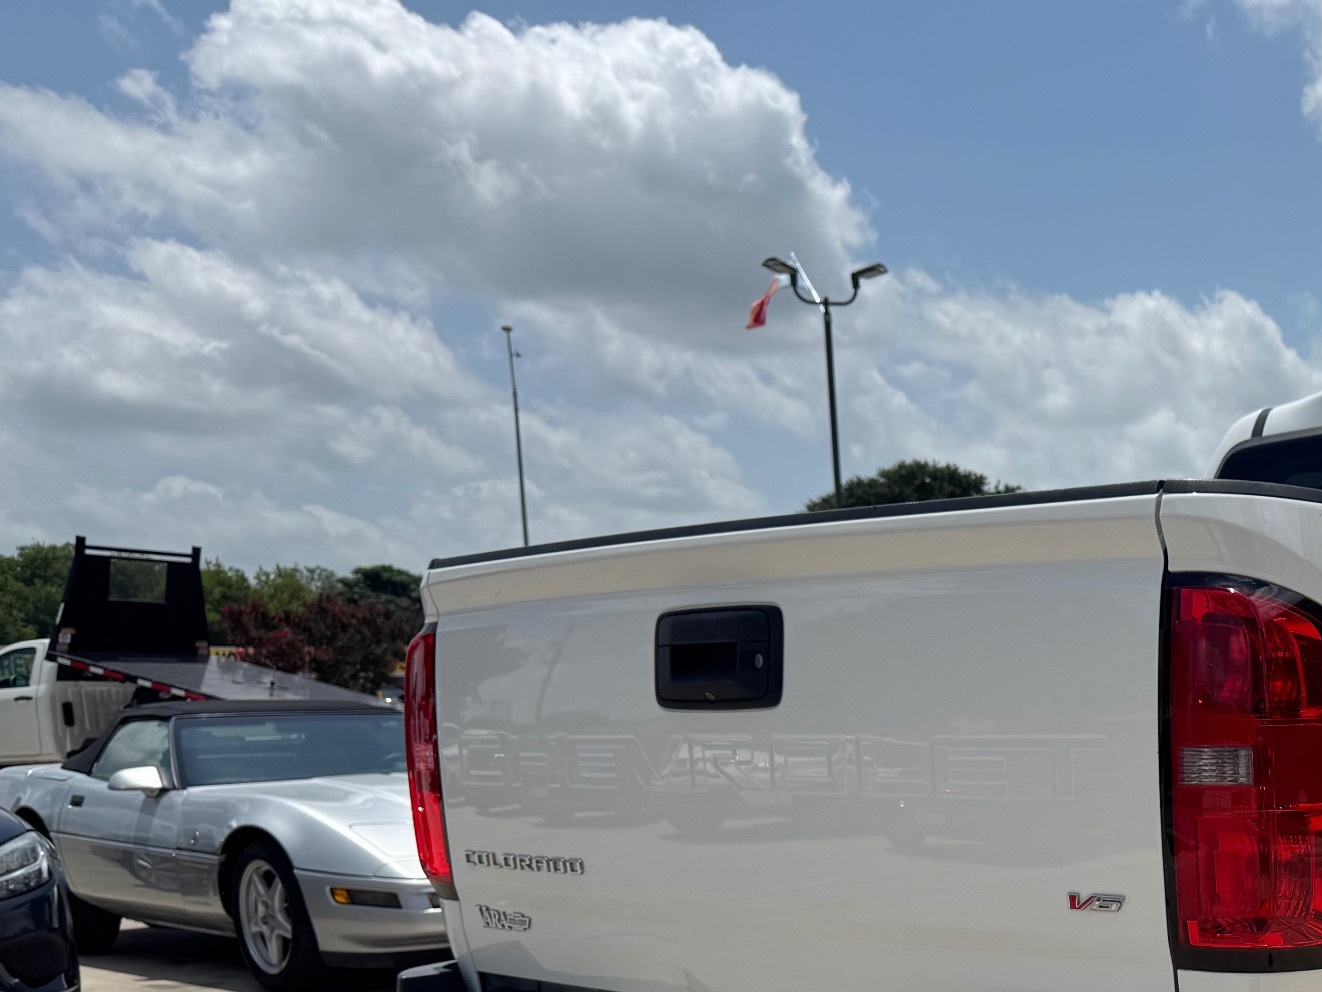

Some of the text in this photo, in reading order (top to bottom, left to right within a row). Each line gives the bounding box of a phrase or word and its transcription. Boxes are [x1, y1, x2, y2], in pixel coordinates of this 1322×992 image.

[460, 734, 1108, 800] CHEVROLET
[464, 849, 586, 875] COLORADO
[1066, 892, 1126, 912] V6
